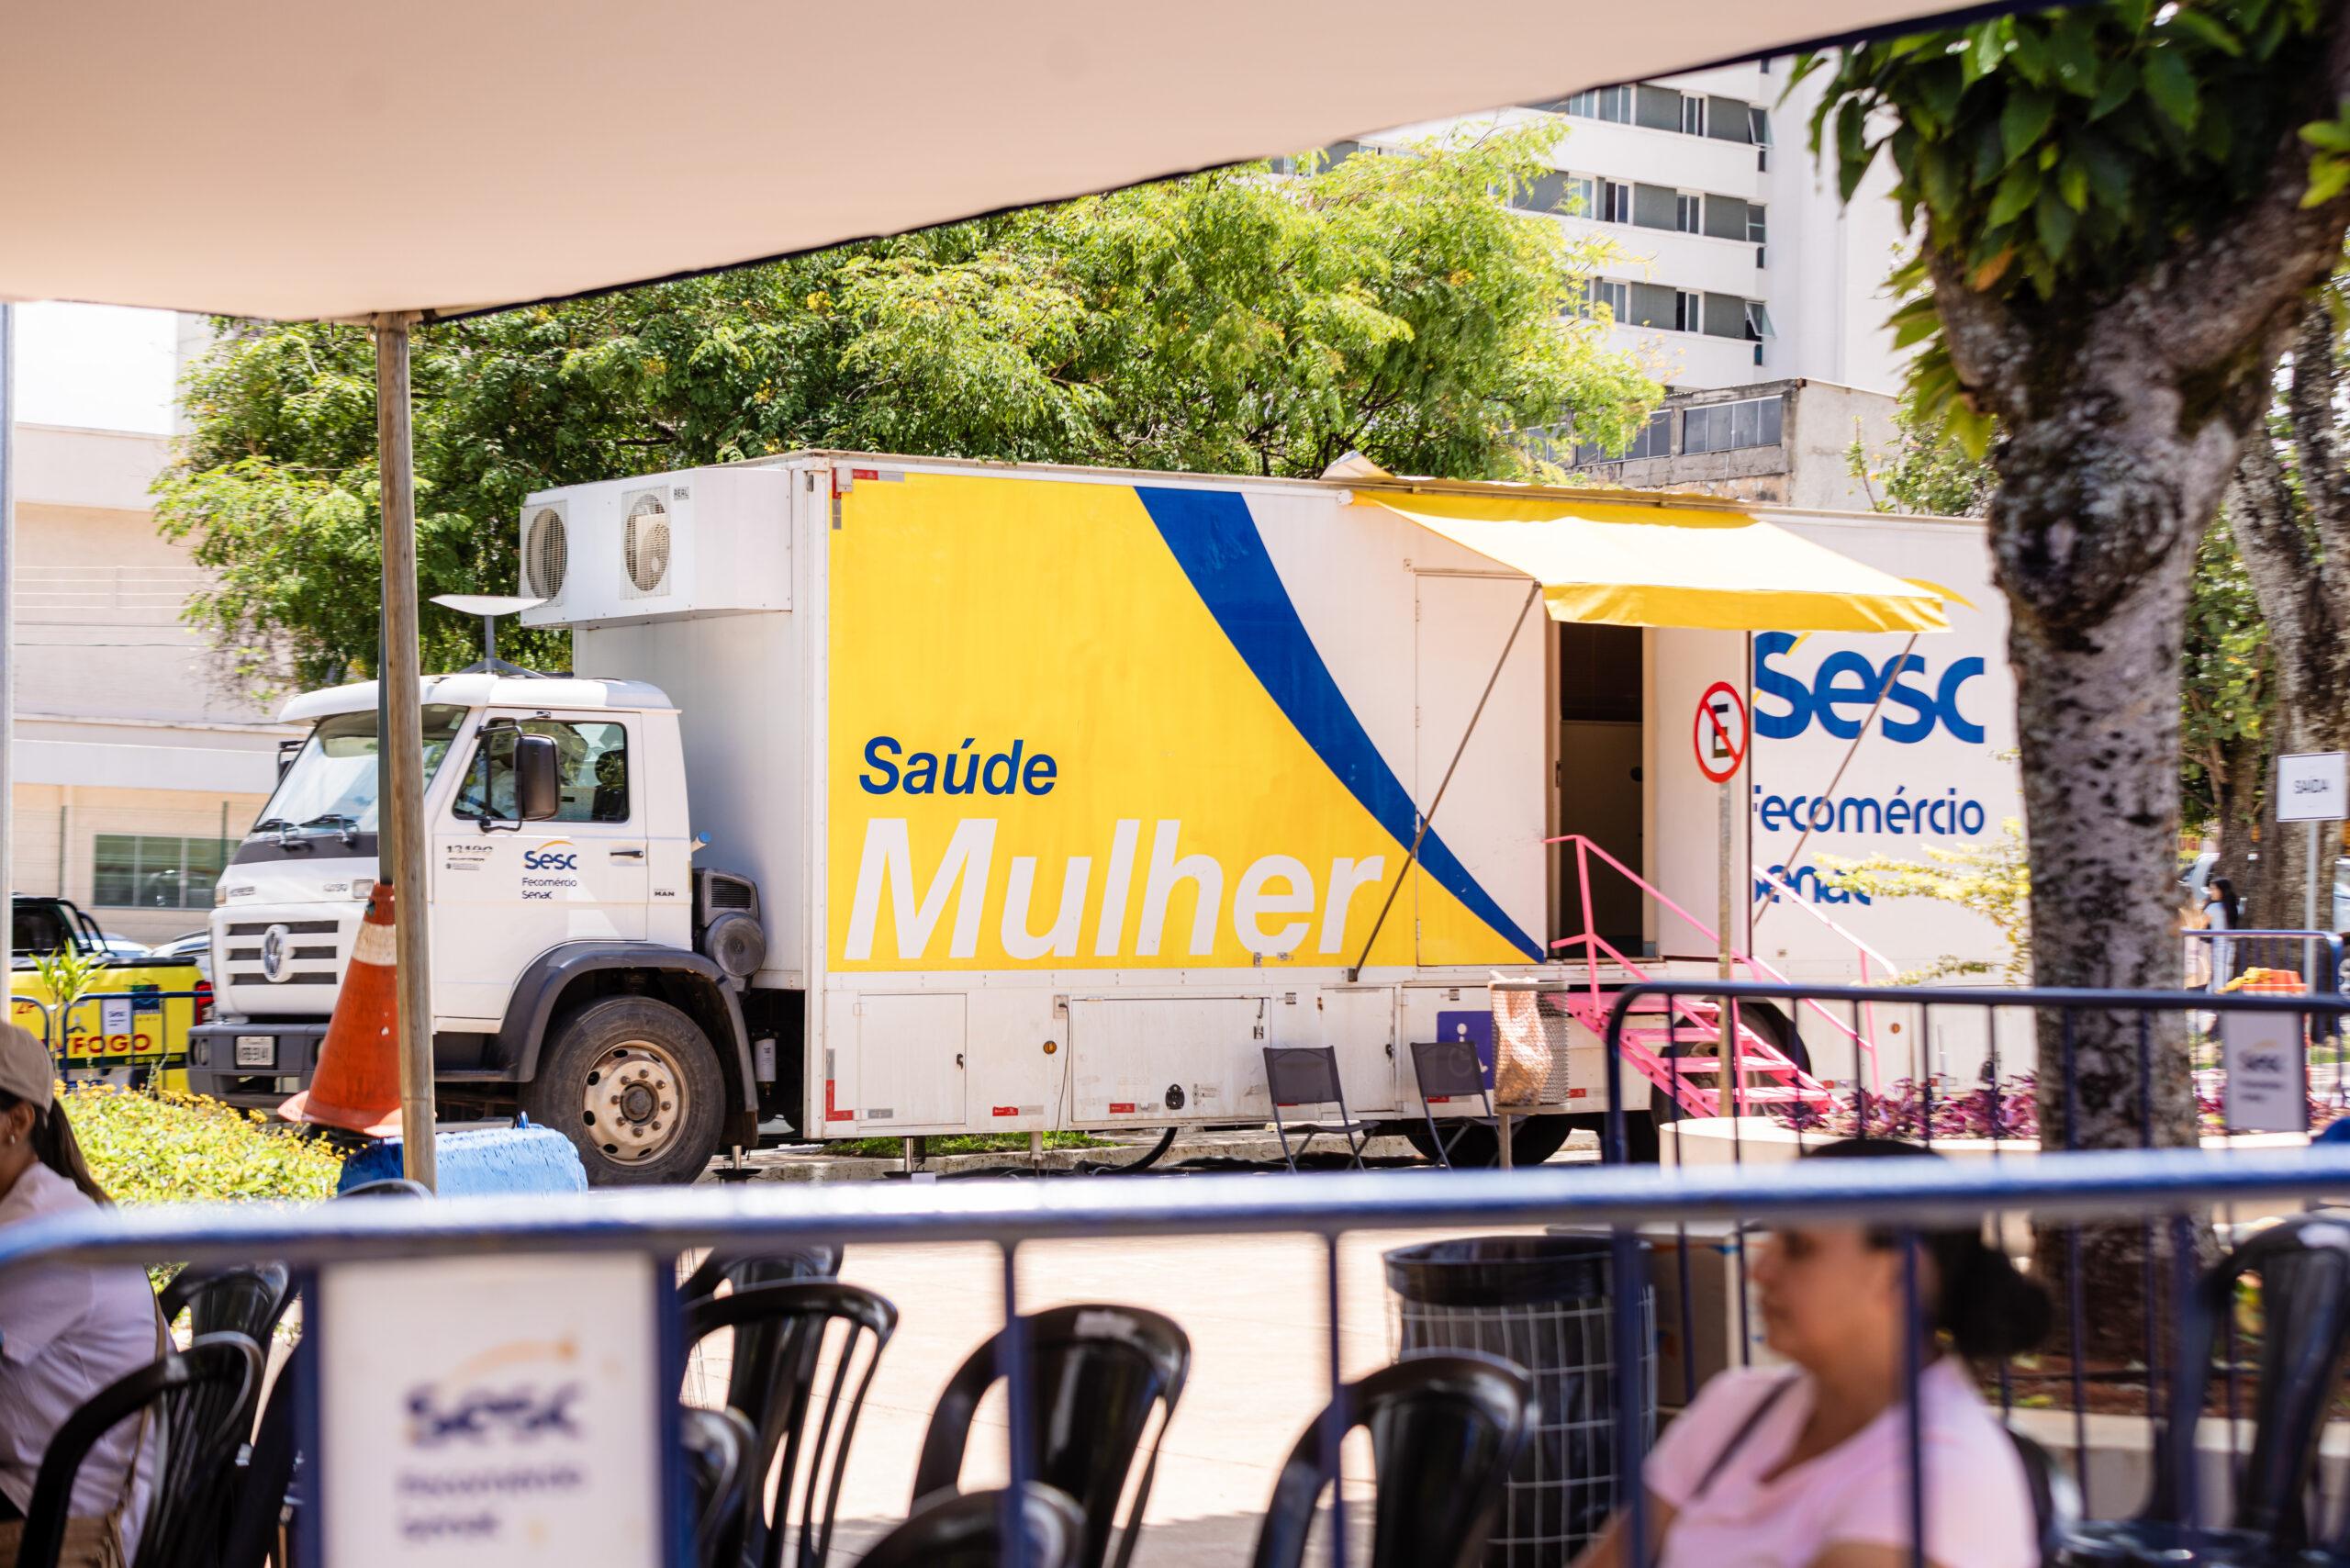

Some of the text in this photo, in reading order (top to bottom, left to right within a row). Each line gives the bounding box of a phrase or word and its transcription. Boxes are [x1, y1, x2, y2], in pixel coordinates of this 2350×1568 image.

[1753, 631, 1985, 745] Sesc
[859, 735, 1058, 796] Saúde
[2294, 775, 2330, 794] SAÍDA
[1753, 785, 1985, 835] ecomércio
[524, 850, 577, 870] Sesc
[522, 877, 577, 888] Fecomércio
[522, 890, 553, 900] Senac
[844, 817, 1386, 960] Mulher
[1753, 864, 1872, 906] ena
